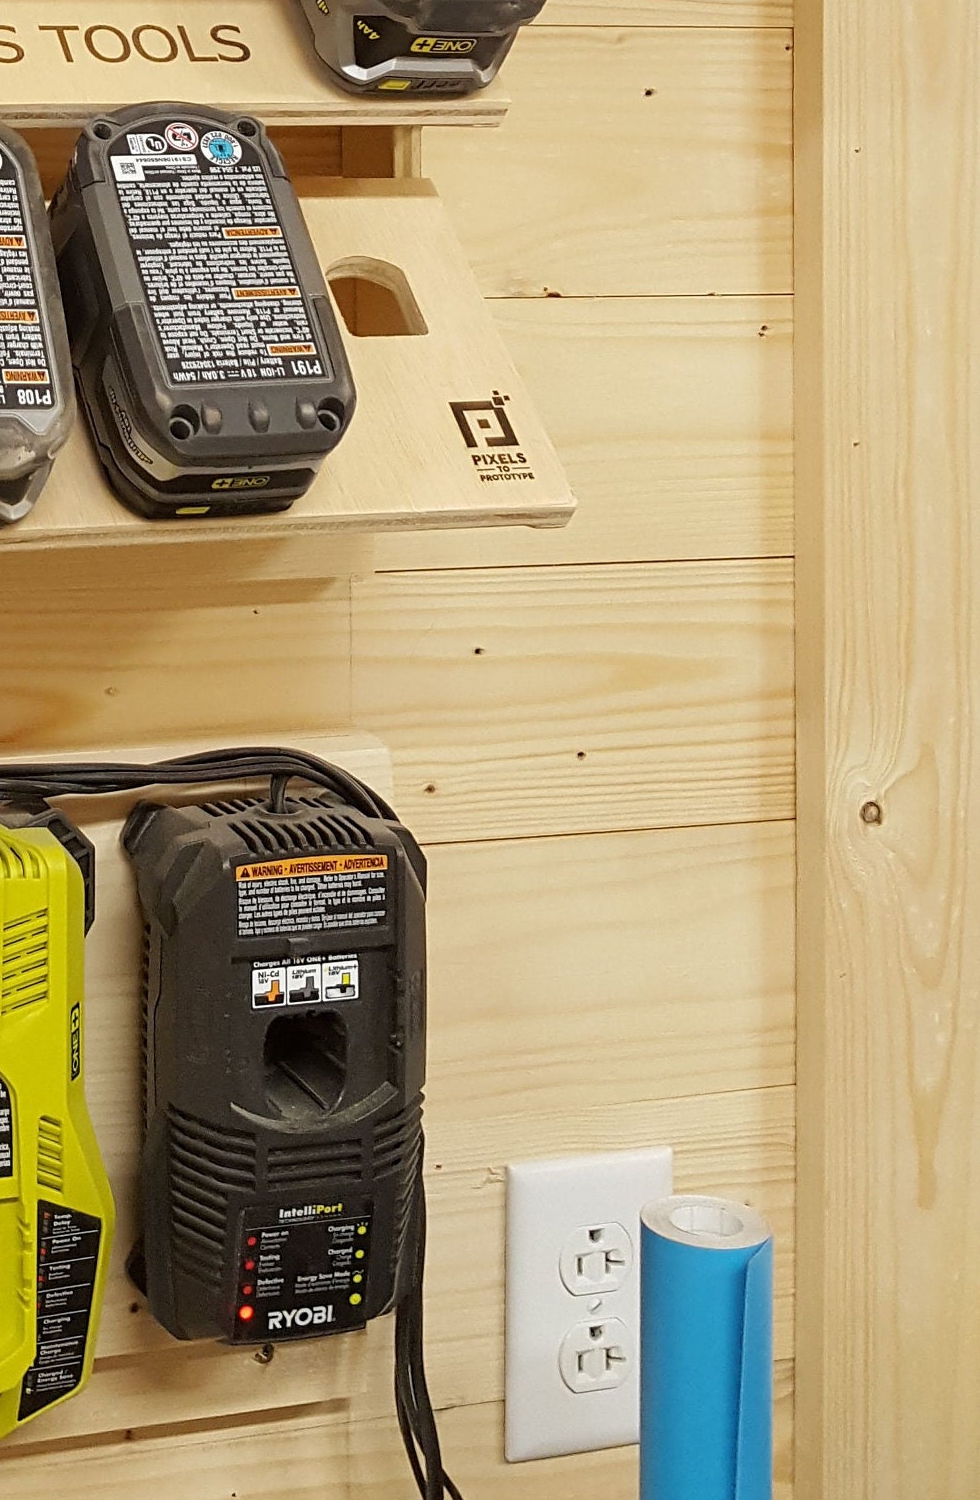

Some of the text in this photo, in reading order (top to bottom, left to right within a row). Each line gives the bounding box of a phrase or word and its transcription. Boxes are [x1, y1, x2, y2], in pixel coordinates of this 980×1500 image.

[357, 20, 380, 39] 4Ah
[39, 24, 252, 63] TOOLS
[411, 38, 476, 53] ONE+
[236, 288, 286, 297] AVERTISSEMENT
[260, 366, 285, 377] LI-ION
[291, 360, 322, 375] P191
[5, 371, 37, 381] WARNING
[173, 372, 196, 381] 54Wh
[202, 370, 225, 380] 3.0Ah
[17, 389, 51, 404] P108
[471, 453, 527, 465] PIXELS
[212, 476, 270, 489] ONE+
[480, 473, 535, 481] PROTOTYPE
[252, 857, 384, 875] WARNING AVERTISSEMENT ADVERTENCIA
[254, 960, 279, 968] Charges
[258, 970, 279, 978] Ni-Cd
[280, 1203, 343, 1218] IntelliPort
[268, 1305, 333, 1330] RYOBI
